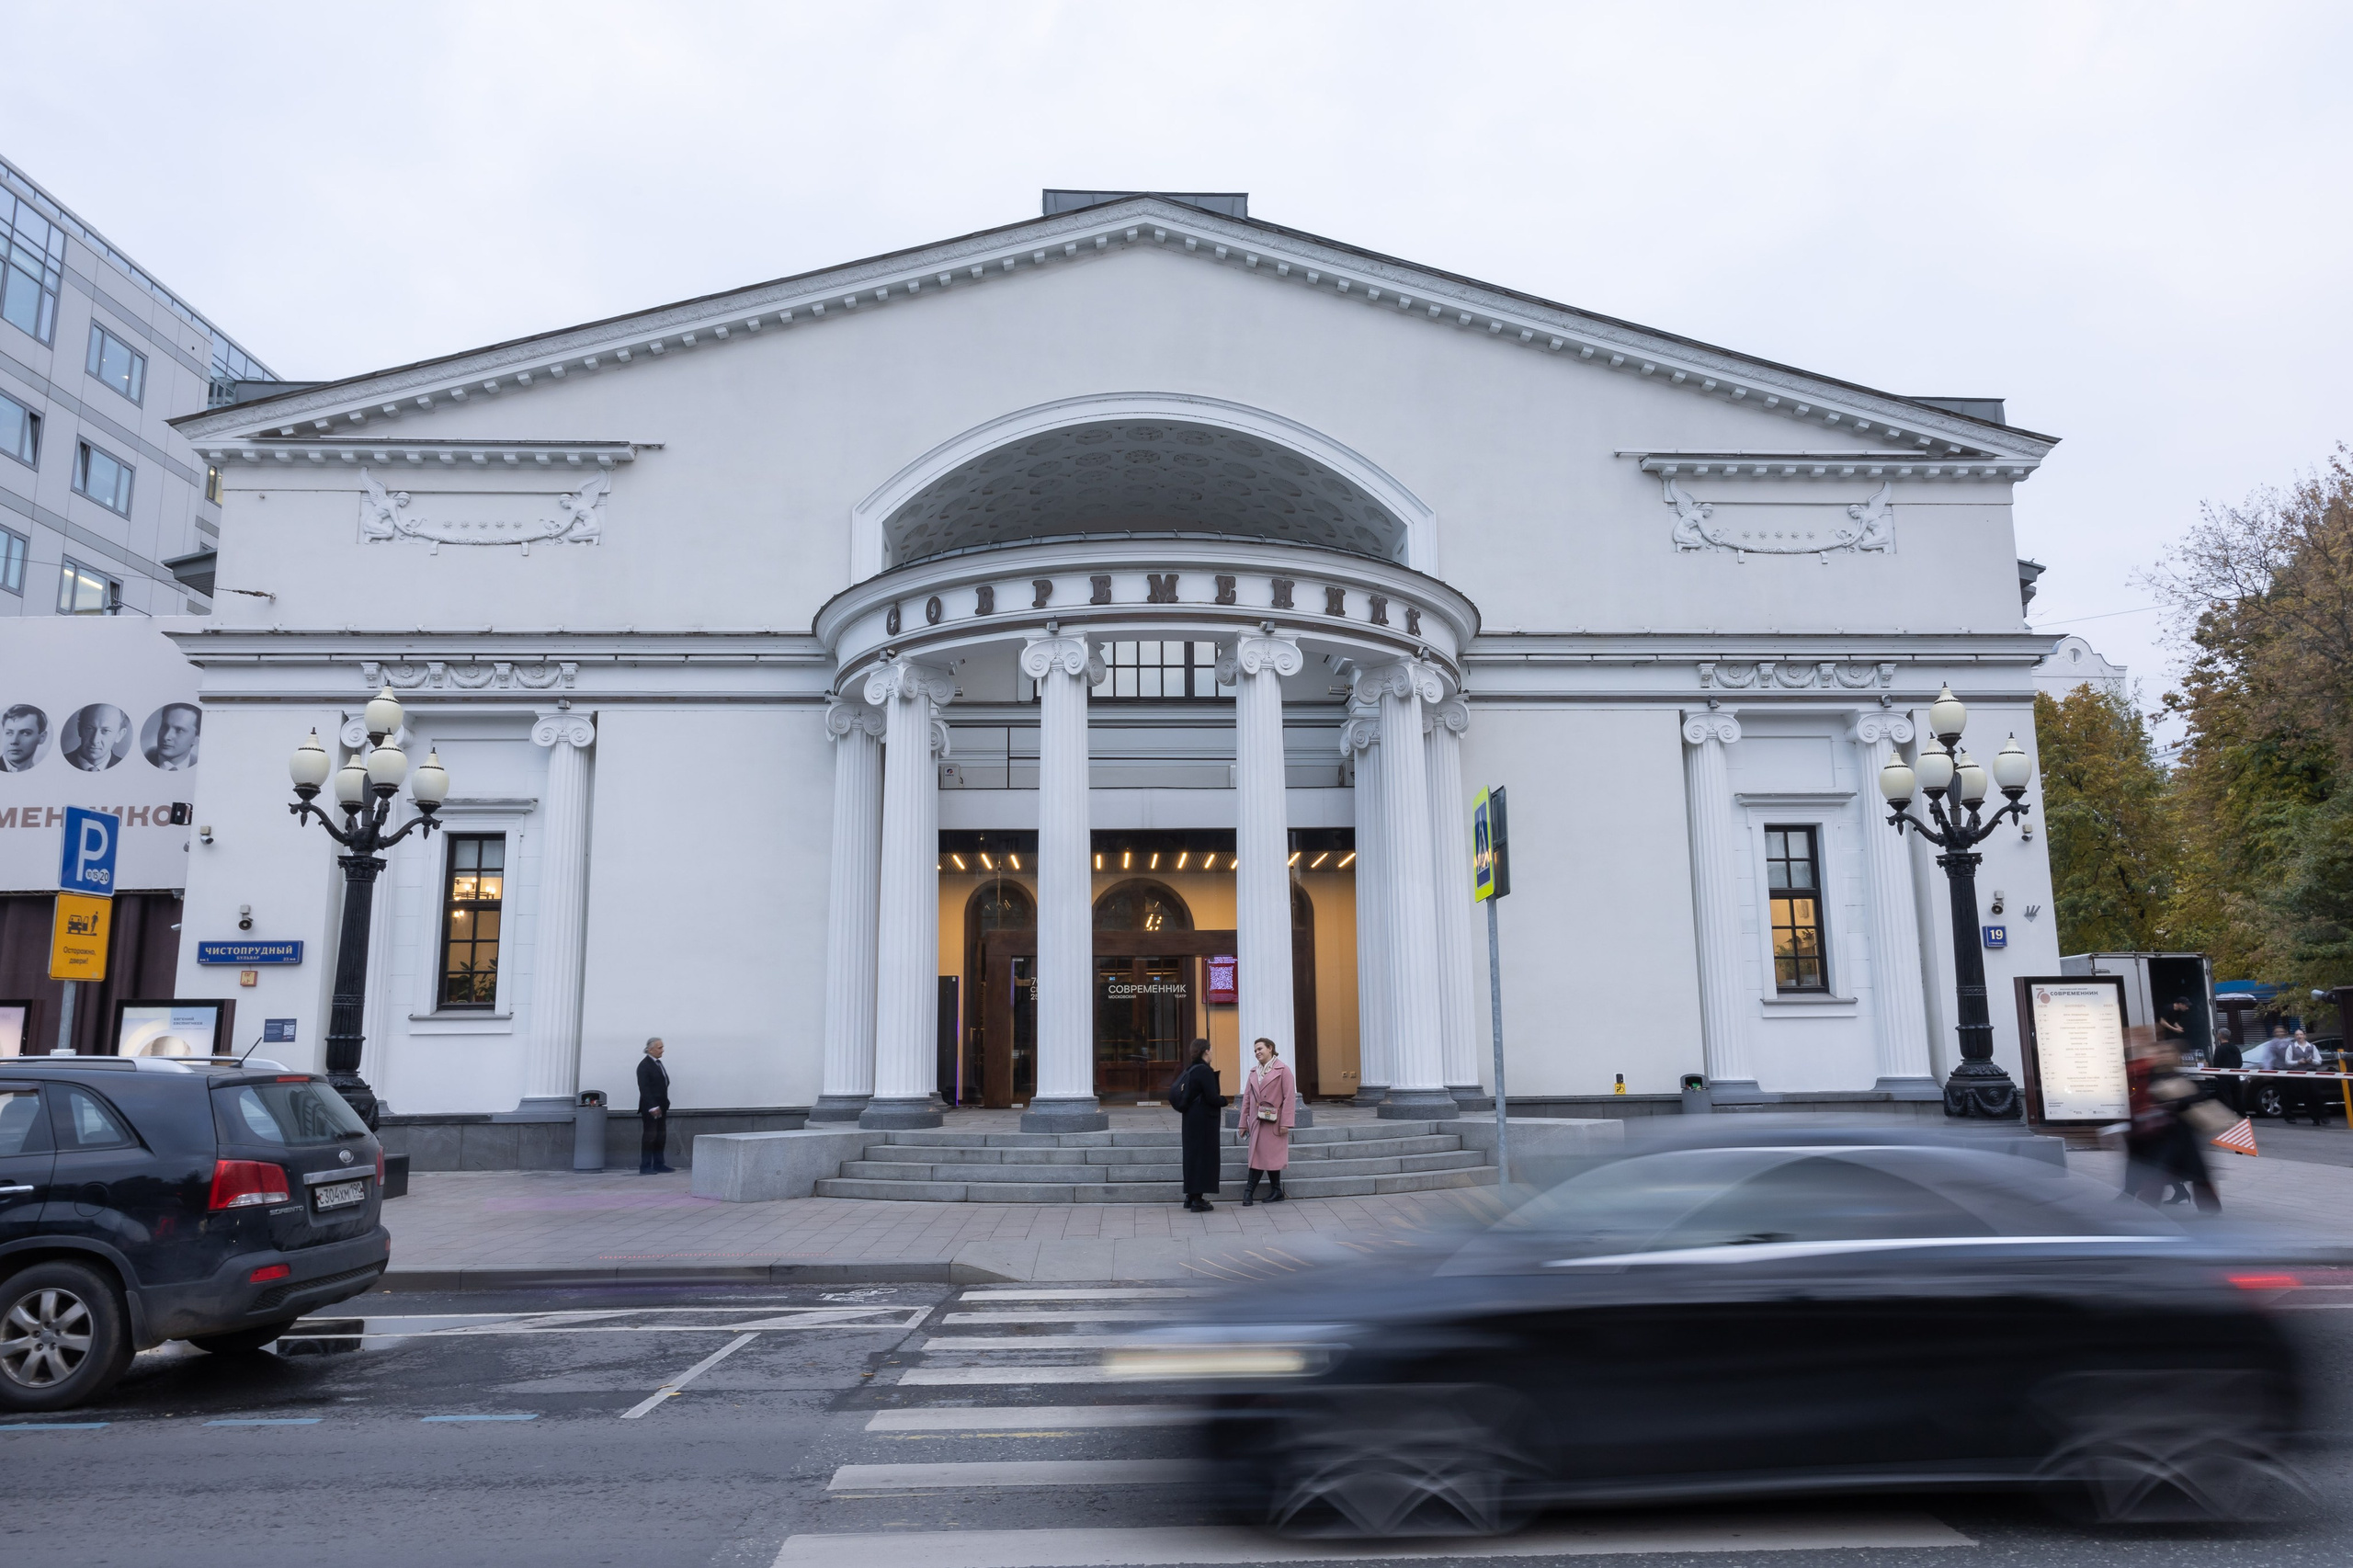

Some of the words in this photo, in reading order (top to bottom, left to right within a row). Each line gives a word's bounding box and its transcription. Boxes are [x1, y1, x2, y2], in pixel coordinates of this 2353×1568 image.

[886, 574, 1422, 636] СОВРЕМЕННИК
[76, 818, 108, 881] P
[99, 871, 108, 881] 20
[1989, 929, 2004, 940] 19
[63, 946, 96, 956] Осторожно,
[205, 945, 292, 955] ЧИСТОПРУДНЫЙ
[69, 957, 88, 966] двери!
[1108, 984, 1187, 994] СОВРЕМЕННИК
[269, 1205, 304, 1216] SORENTO
